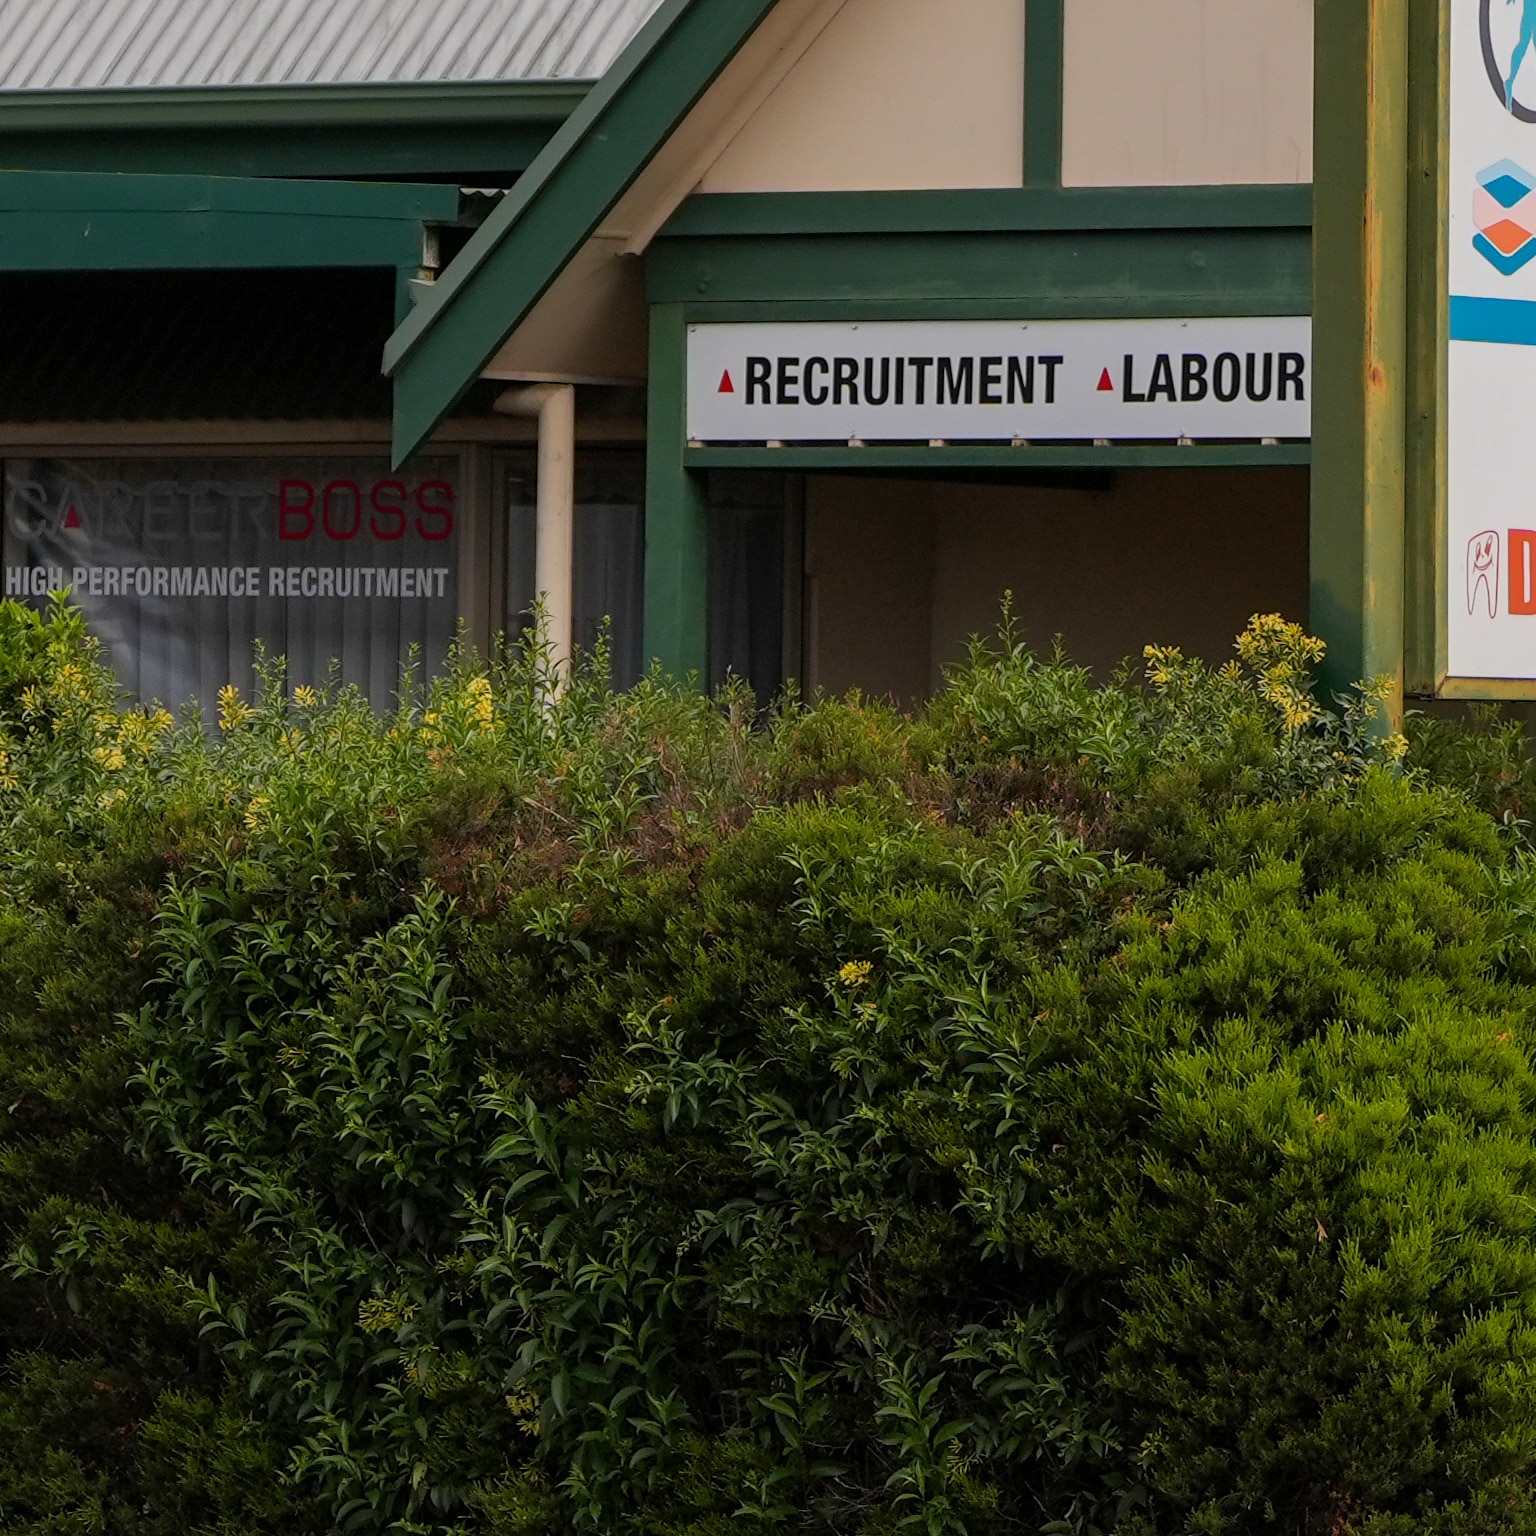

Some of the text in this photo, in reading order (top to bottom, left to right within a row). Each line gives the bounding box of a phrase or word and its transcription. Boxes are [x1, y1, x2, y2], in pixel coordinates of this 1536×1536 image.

[744, 352, 1306, 406] RECRUITMENT LABOUR
[5, 566, 449, 599] HIGH PERFORMANCE RECRUITMENT
